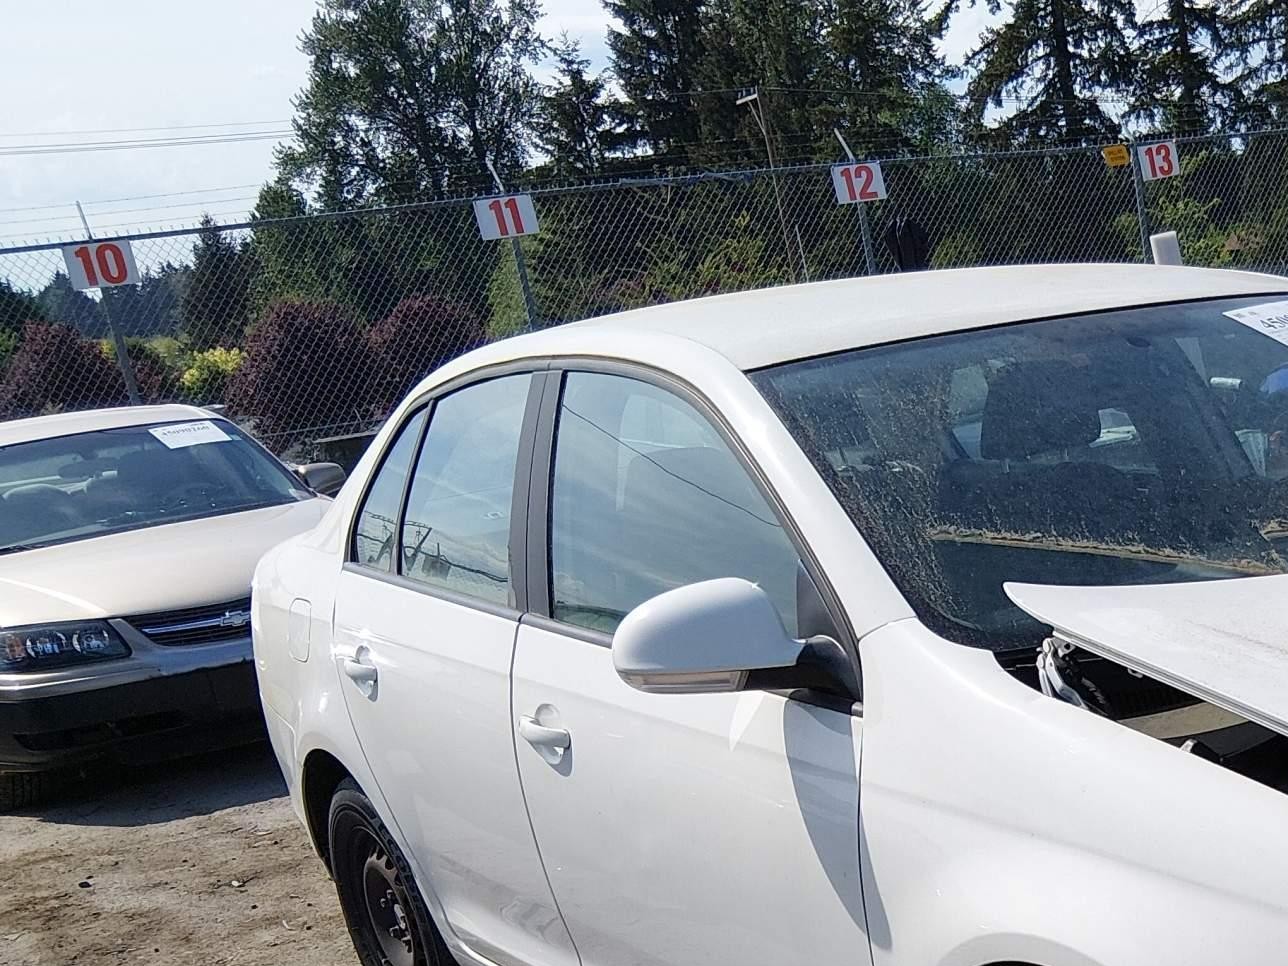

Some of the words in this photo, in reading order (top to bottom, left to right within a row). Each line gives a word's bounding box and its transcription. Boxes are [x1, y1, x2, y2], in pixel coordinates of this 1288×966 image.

[1144, 144, 1173, 178] 13
[840, 165, 879, 201] 12
[488, 197, 525, 235] 11
[74, 243, 129, 286] 10
